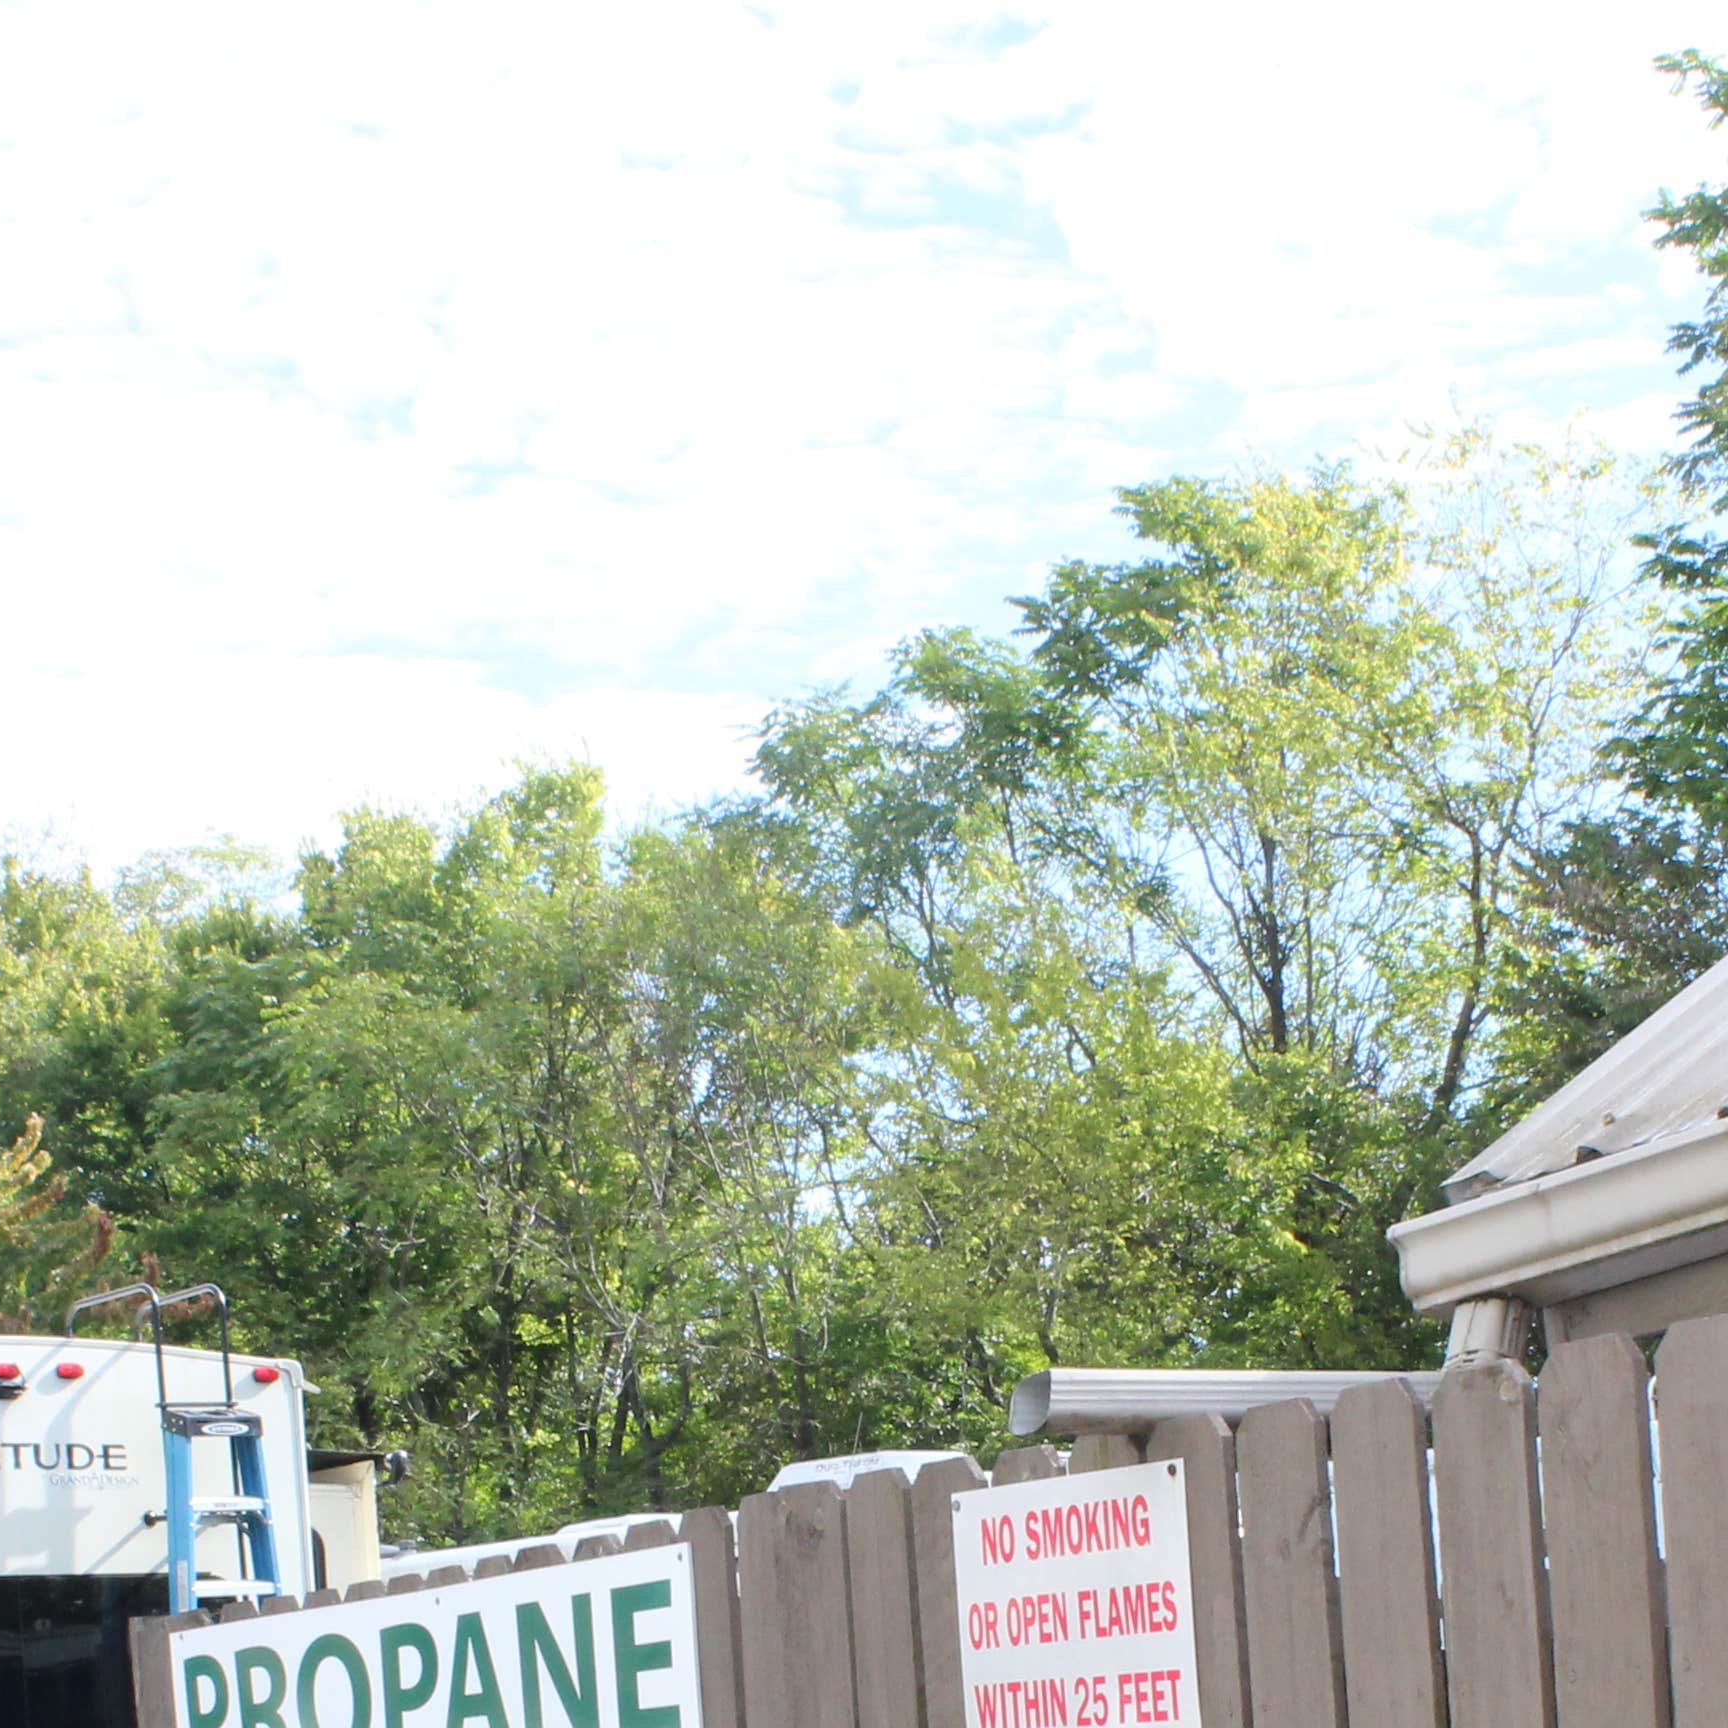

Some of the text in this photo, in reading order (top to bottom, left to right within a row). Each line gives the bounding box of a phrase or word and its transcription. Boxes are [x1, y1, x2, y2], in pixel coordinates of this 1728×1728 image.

[981, 1495, 1152, 1566] NO SMOKING
[968, 1580, 1178, 1651] OR OPEN FLAMES
[1074, 1675, 1109, 1727] 25
[1118, 1669, 1182, 1725] FEET
